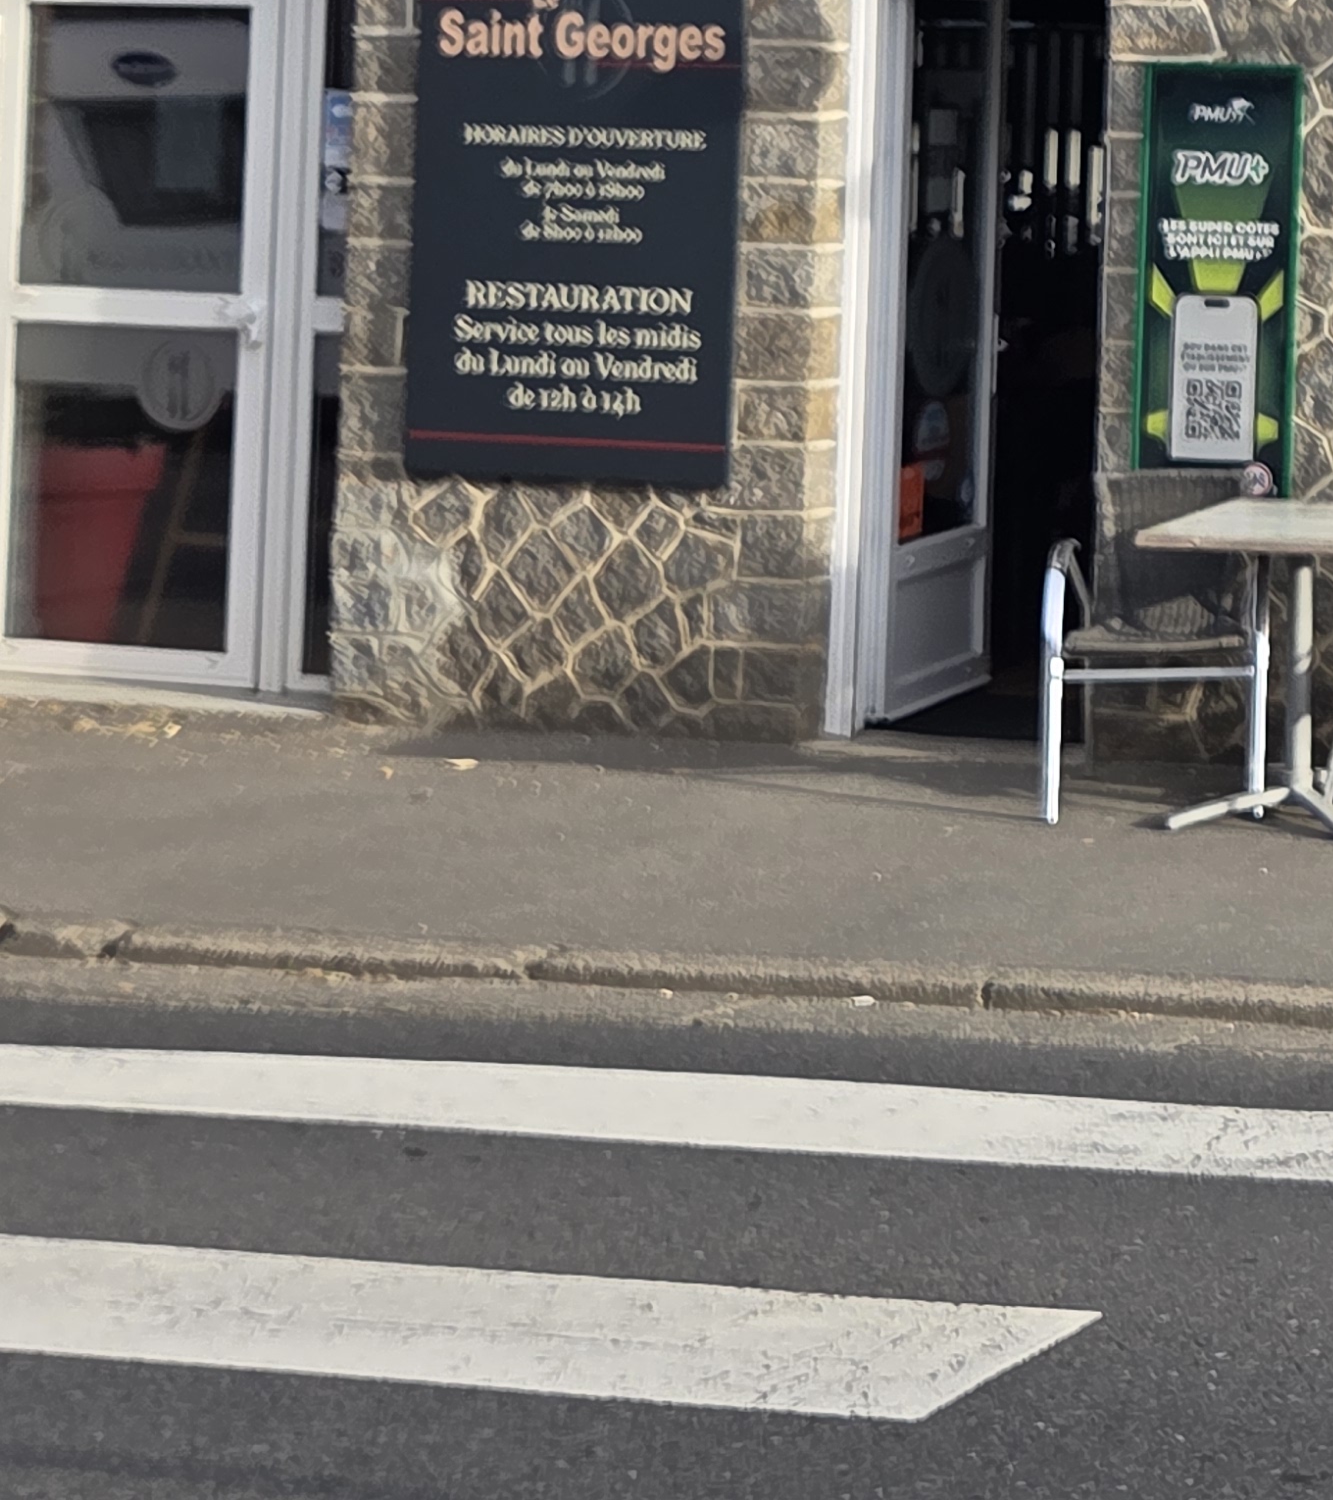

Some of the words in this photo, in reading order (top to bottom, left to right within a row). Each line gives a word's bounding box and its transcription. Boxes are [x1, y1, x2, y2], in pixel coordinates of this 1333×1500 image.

[438, 6, 544, 59] Saint
[554, 10, 727, 74] Georges
[463, 123, 567, 146] HORAIRES
[567, 125, 707, 152] D'OUVERTURE
[465, 279, 695, 317] RESTAURATION
[453, 313, 541, 344] Service
[543, 320, 594, 347] tous
[594, 318, 632, 349] les
[634, 322, 702, 352] midis
[453, 346, 486, 375] du
[487, 347, 557, 379] Lundi
[559, 356, 591, 379] au
[593, 351, 699, 385] Vendredi
[506, 380, 537, 411] de
[536, 383, 578, 412] 12h
[600, 386, 643, 421] 14h
